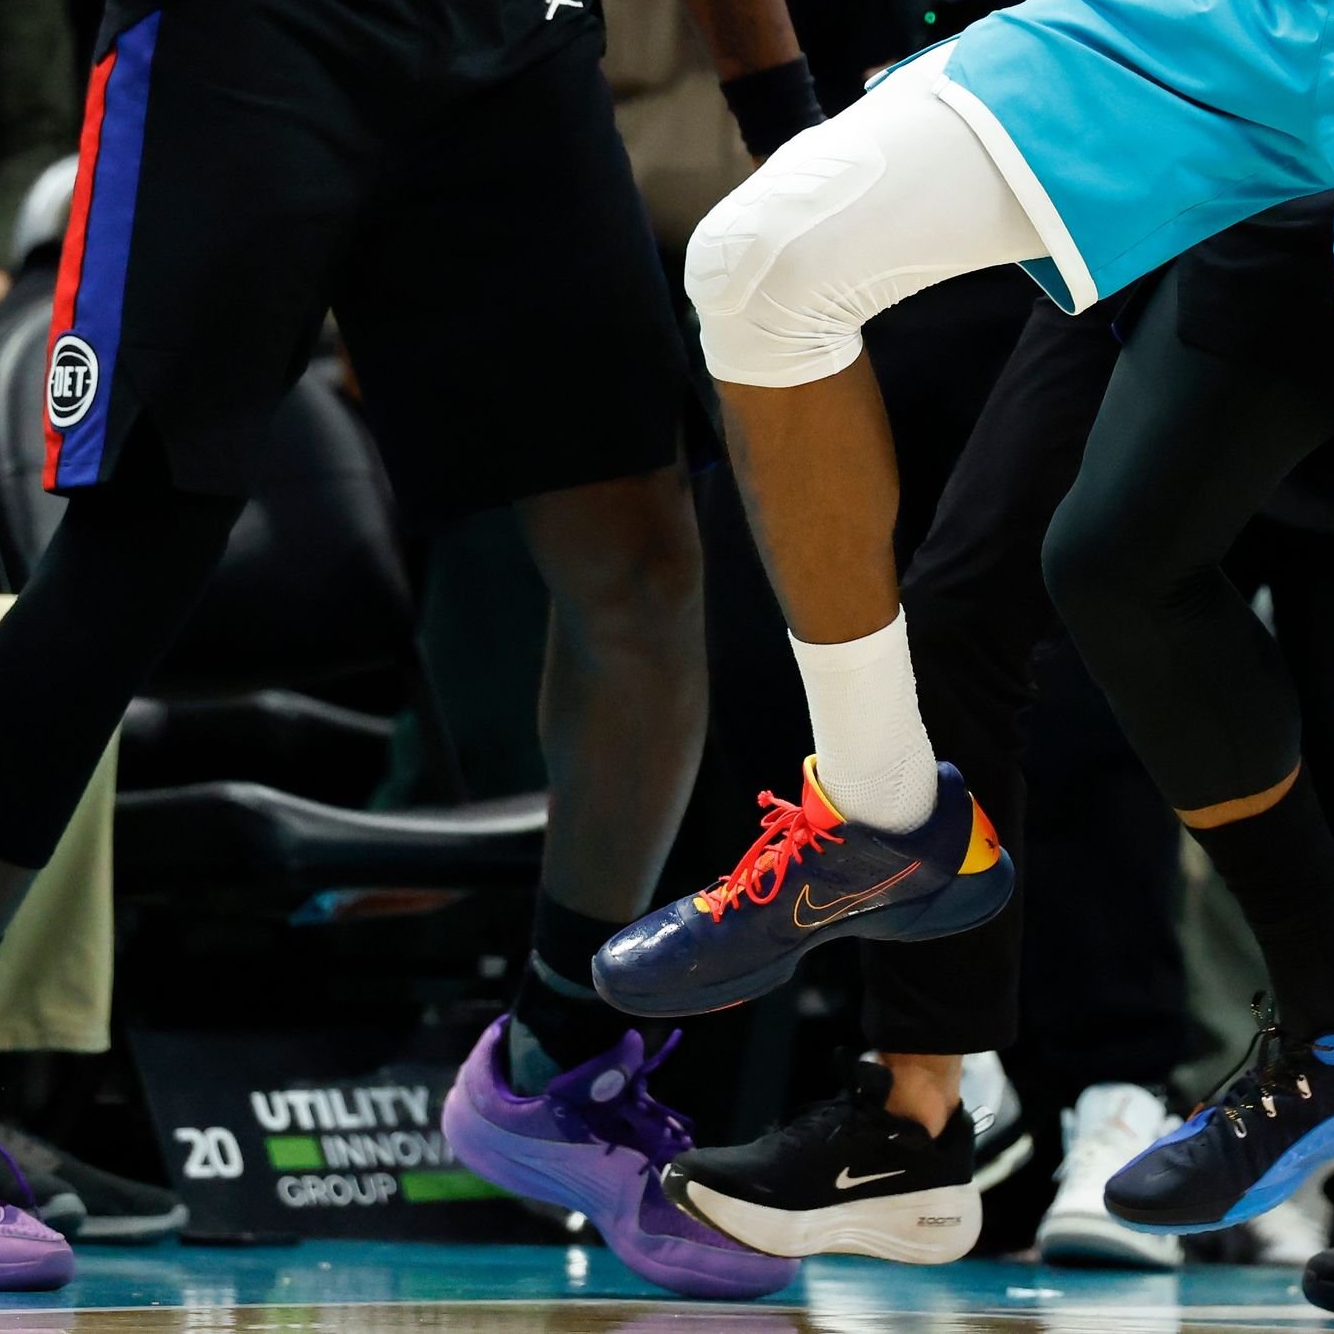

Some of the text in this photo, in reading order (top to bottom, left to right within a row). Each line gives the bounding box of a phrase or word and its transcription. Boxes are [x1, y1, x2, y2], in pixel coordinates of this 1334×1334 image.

[53, 365, 88, 398] DET
[250, 1086, 430, 1132] UTILITY
[172, 1127, 244, 1179] 20
[321, 1130, 455, 1168] INNOV
[276, 1172, 398, 1208] GROUP
